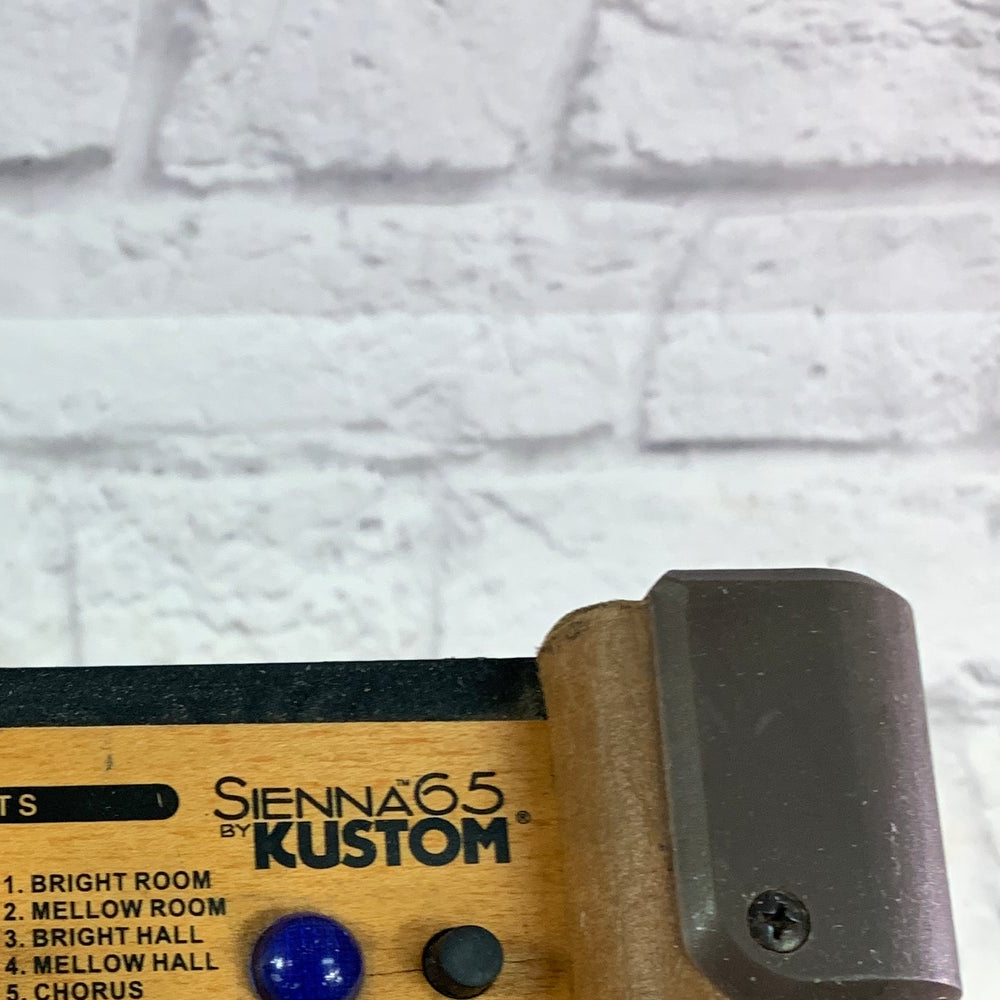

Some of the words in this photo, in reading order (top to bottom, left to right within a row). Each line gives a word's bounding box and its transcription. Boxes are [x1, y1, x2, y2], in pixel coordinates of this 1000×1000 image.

[414, 772, 505, 816] 65
[220, 823, 252, 838] BY
[3, 875, 24, 894] 1.
[31, 873, 127, 893] BRIGHT
[136, 870, 212, 890] ROOM
[3, 903, 24, 922] 2.
[32, 899, 143, 920] MELLOW
[150, 898, 227, 917] ROOM
[4, 929, 25, 948] 3.
[33, 928, 129, 947] BRIGHT
[137, 926, 204, 945] HALL
[5, 957, 26, 975] 4.
[33, 954, 146, 974] MELLOW
[153, 952, 219, 972] HALL
